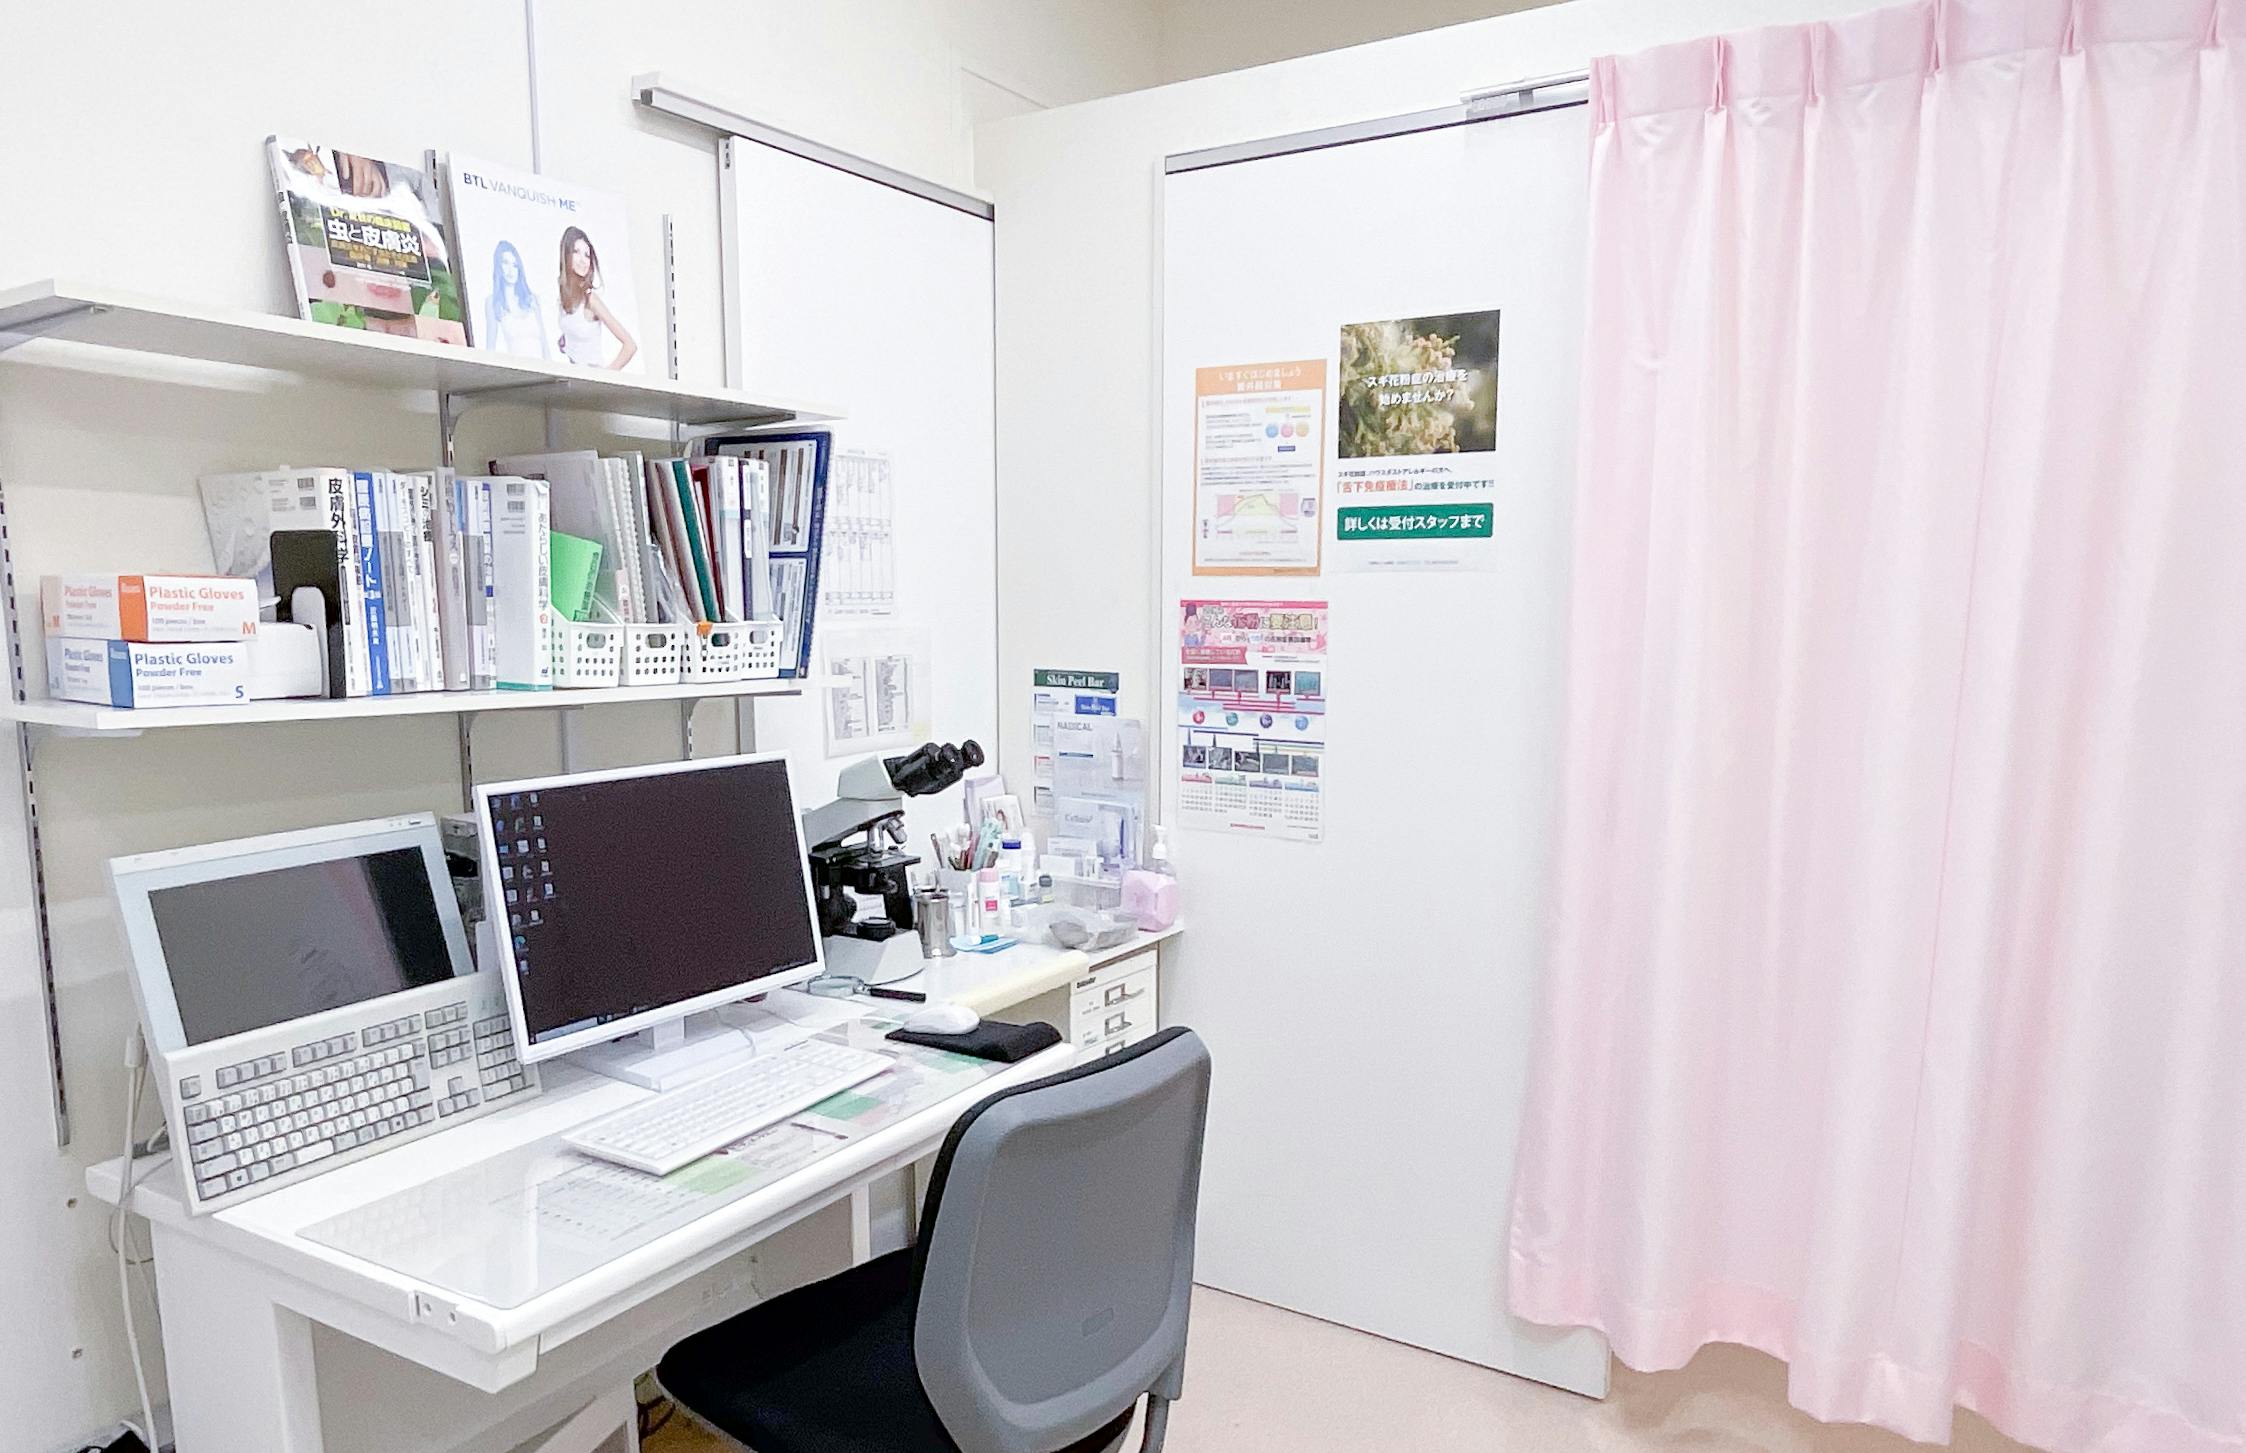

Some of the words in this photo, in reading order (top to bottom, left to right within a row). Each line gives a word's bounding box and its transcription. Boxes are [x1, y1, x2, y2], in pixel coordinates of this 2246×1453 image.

[463, 172, 488, 190] BTL
[488, 178, 556, 207] VANQUISH
[558, 197, 577, 212] ME
[326, 217, 422, 257] 虫と皮膚炎
[1344, 513, 1486, 532] 詳しくは受付スタッフまで
[149, 586, 196, 599] Plastic
[198, 587, 245, 600] Gloves
[150, 601, 190, 611] Powder
[242, 621, 257, 635] M
[134, 652, 182, 665] Plastic
[186, 652, 234, 665] Gloves
[136, 668, 176, 677] Powder
[179, 667, 202, 677] Free
[1046, 674, 1067, 686] Skin
[1068, 675, 1086, 687] Peel
[1088, 676, 1104, 687] Bar
[235, 685, 245, 699] S
